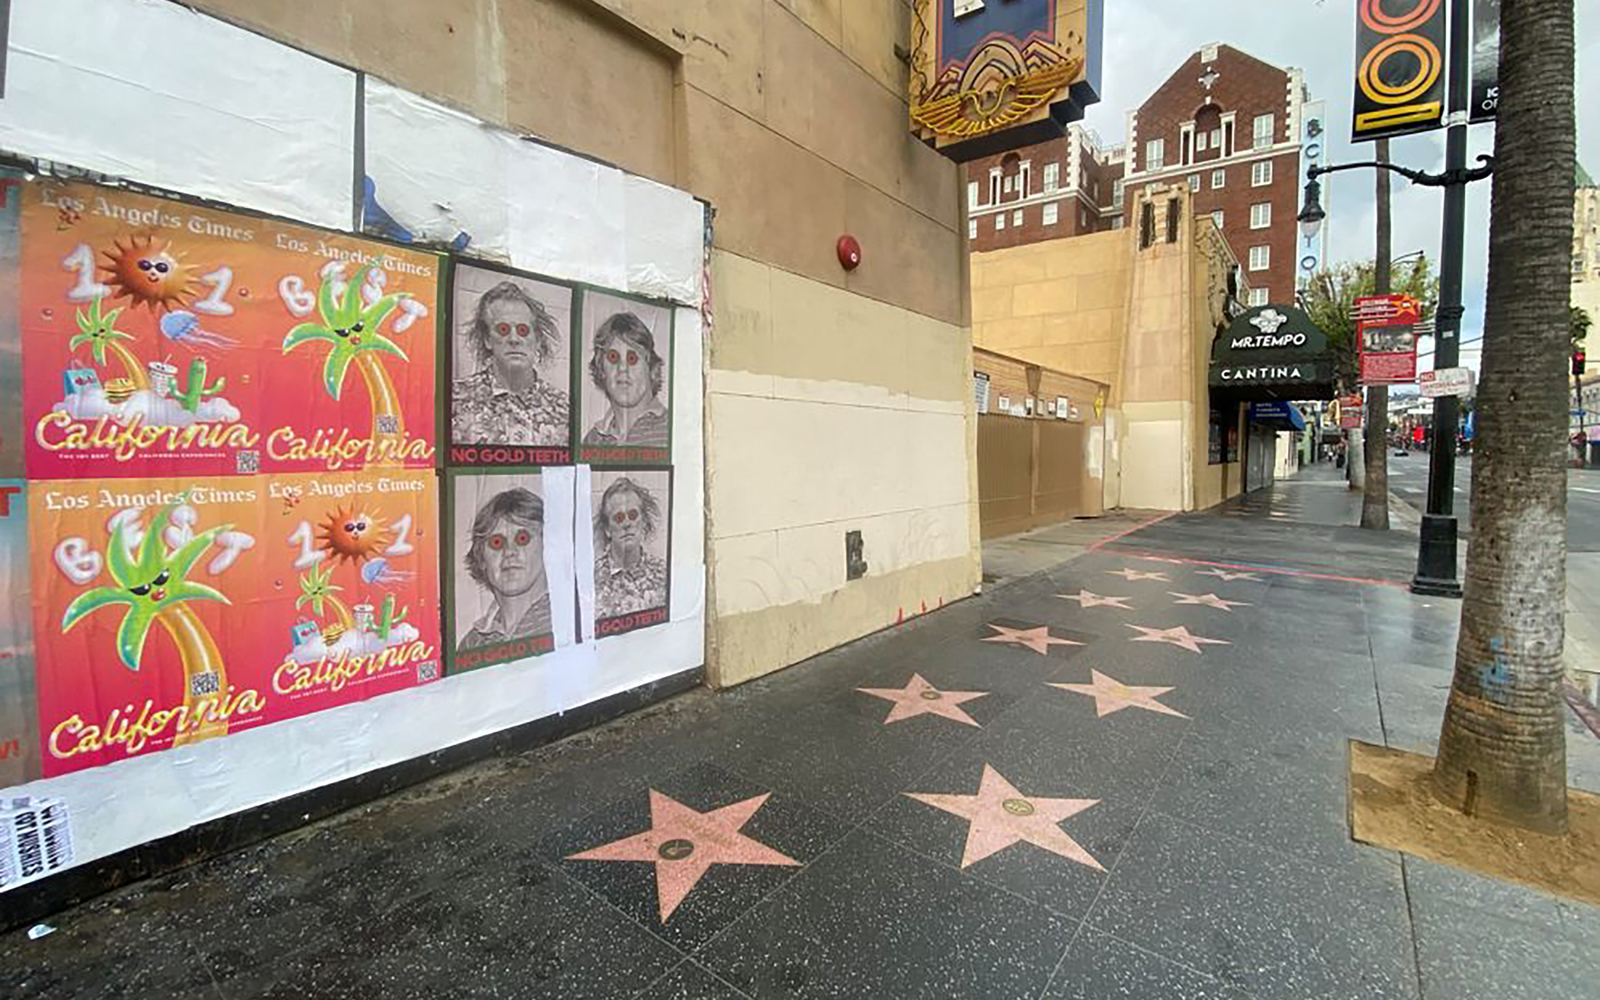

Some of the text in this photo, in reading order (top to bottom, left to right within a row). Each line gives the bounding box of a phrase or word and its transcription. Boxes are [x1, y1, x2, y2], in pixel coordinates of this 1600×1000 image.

[41, 188, 255, 241] Los Angeles Times
[276, 233, 432, 277] Los Angeles Times
[1221, 367, 1301, 379] CANTINA
[35, 410, 260, 462] California
[266, 425, 435, 470] California
[451, 448, 570, 463] NO GOLD TEETH
[46, 486, 257, 511] Los Angeles Times
[269, 477, 425, 498] Los Angeles Times
[272, 639, 434, 694] California
[48, 686, 265, 758] California
